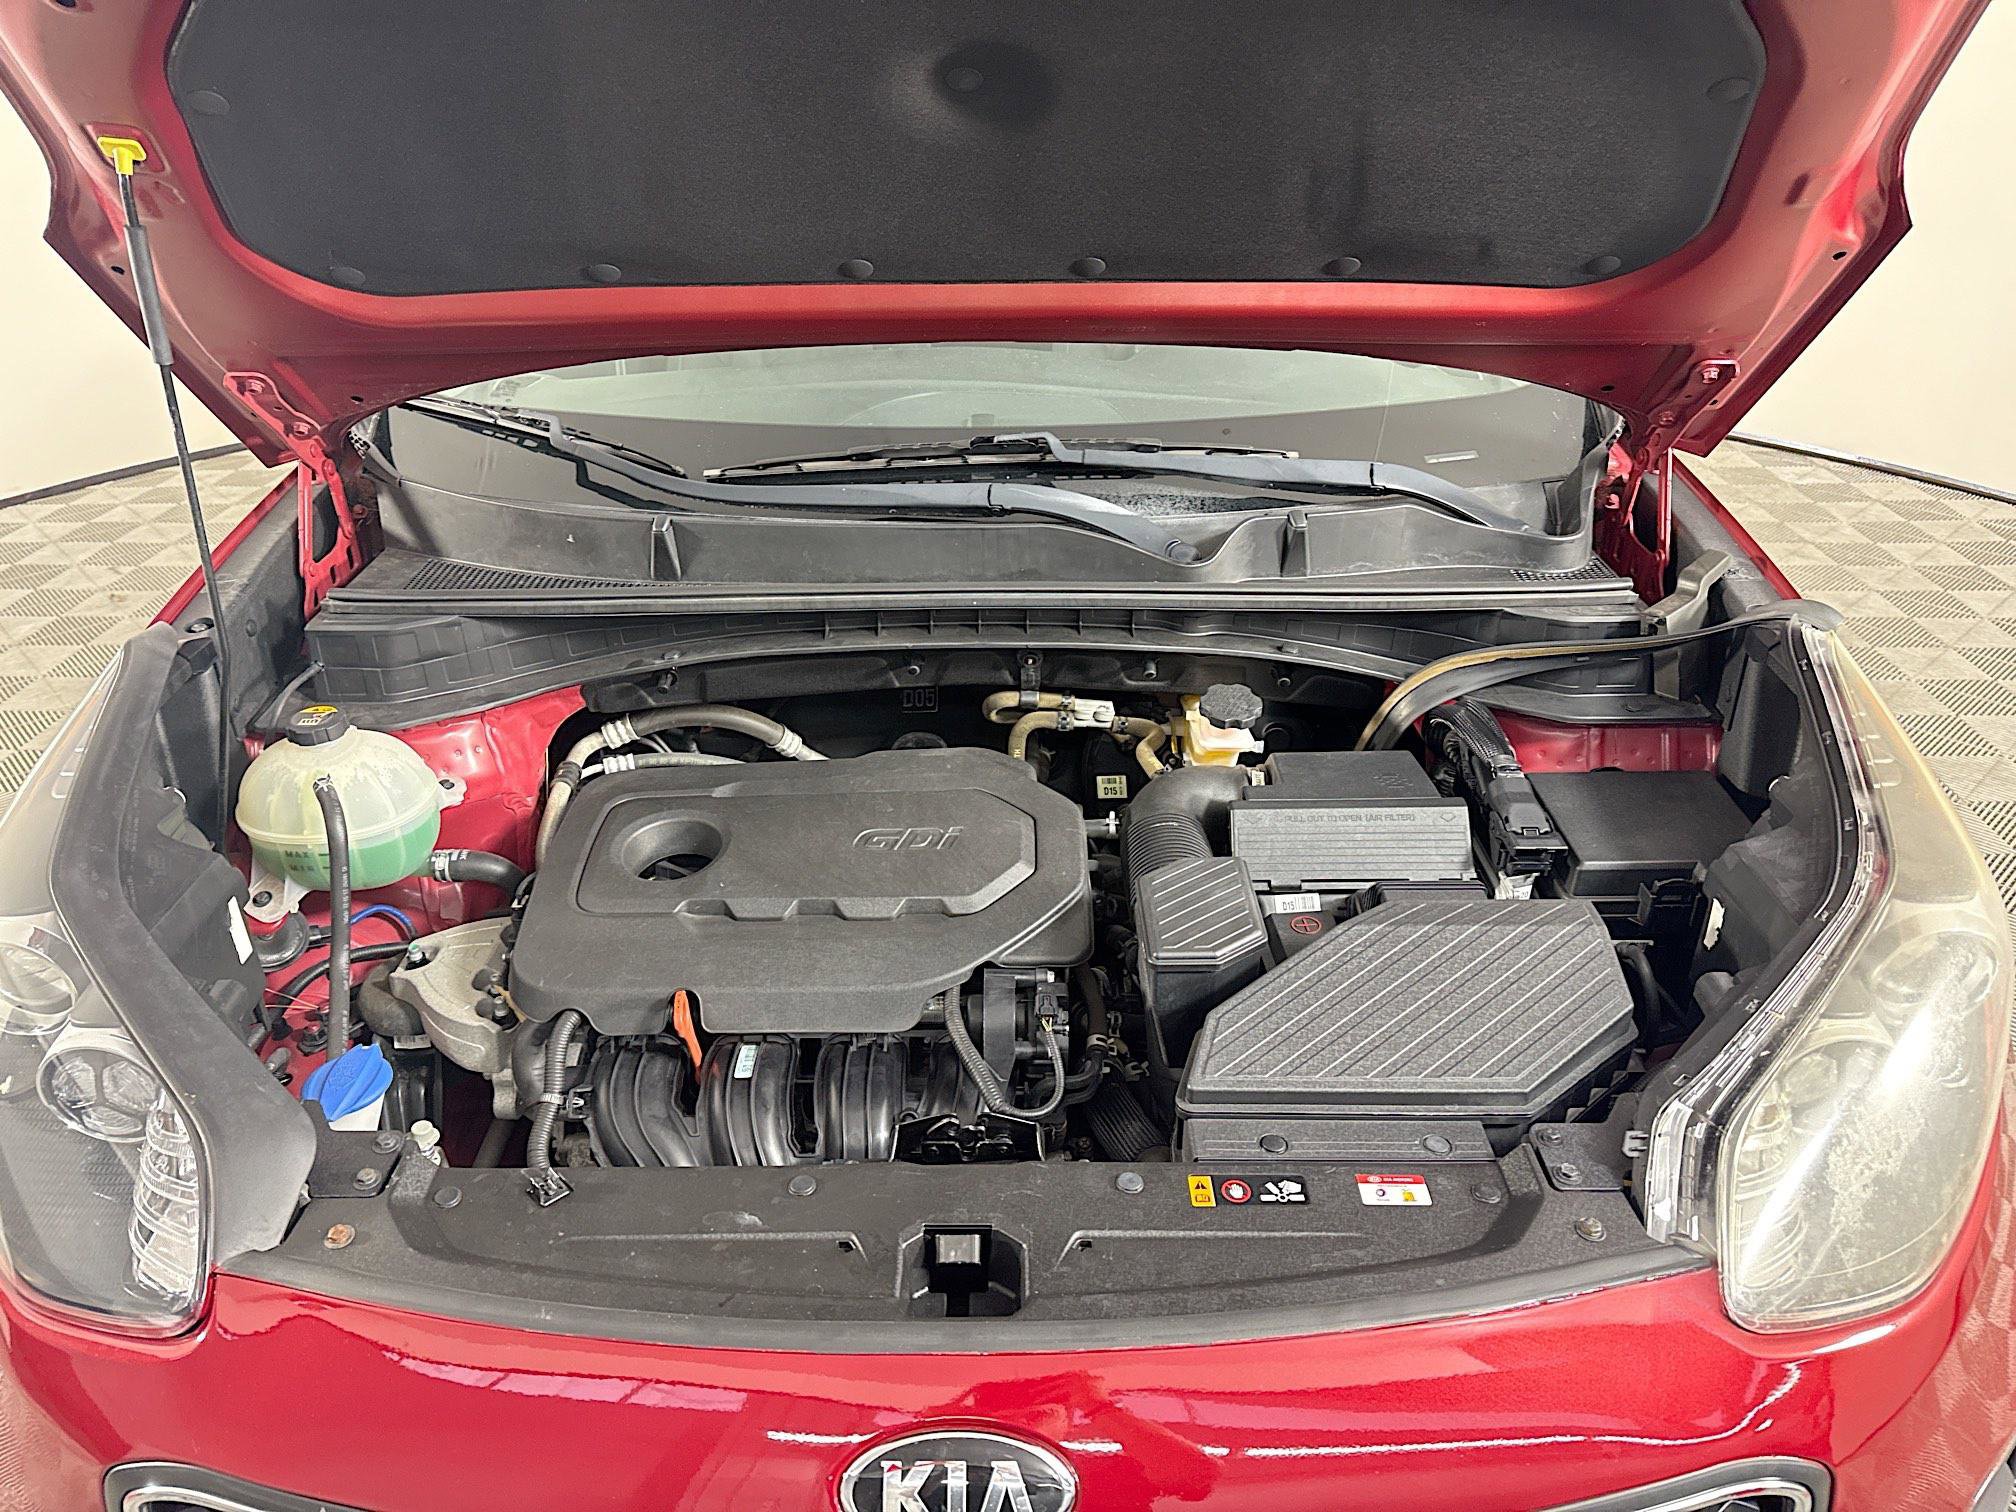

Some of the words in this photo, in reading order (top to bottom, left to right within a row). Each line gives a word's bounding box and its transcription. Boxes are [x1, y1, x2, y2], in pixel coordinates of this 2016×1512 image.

[1103, 786, 1118, 796] D15
[1307, 814, 1325, 822] OUT
[1338, 814, 1362, 822] OPEN
[1384, 813, 1416, 822] FILTER)
[852, 826, 965, 851] GDi
[284, 849, 309, 858] MAX
[880, 1460, 1036, 1512] KIA
